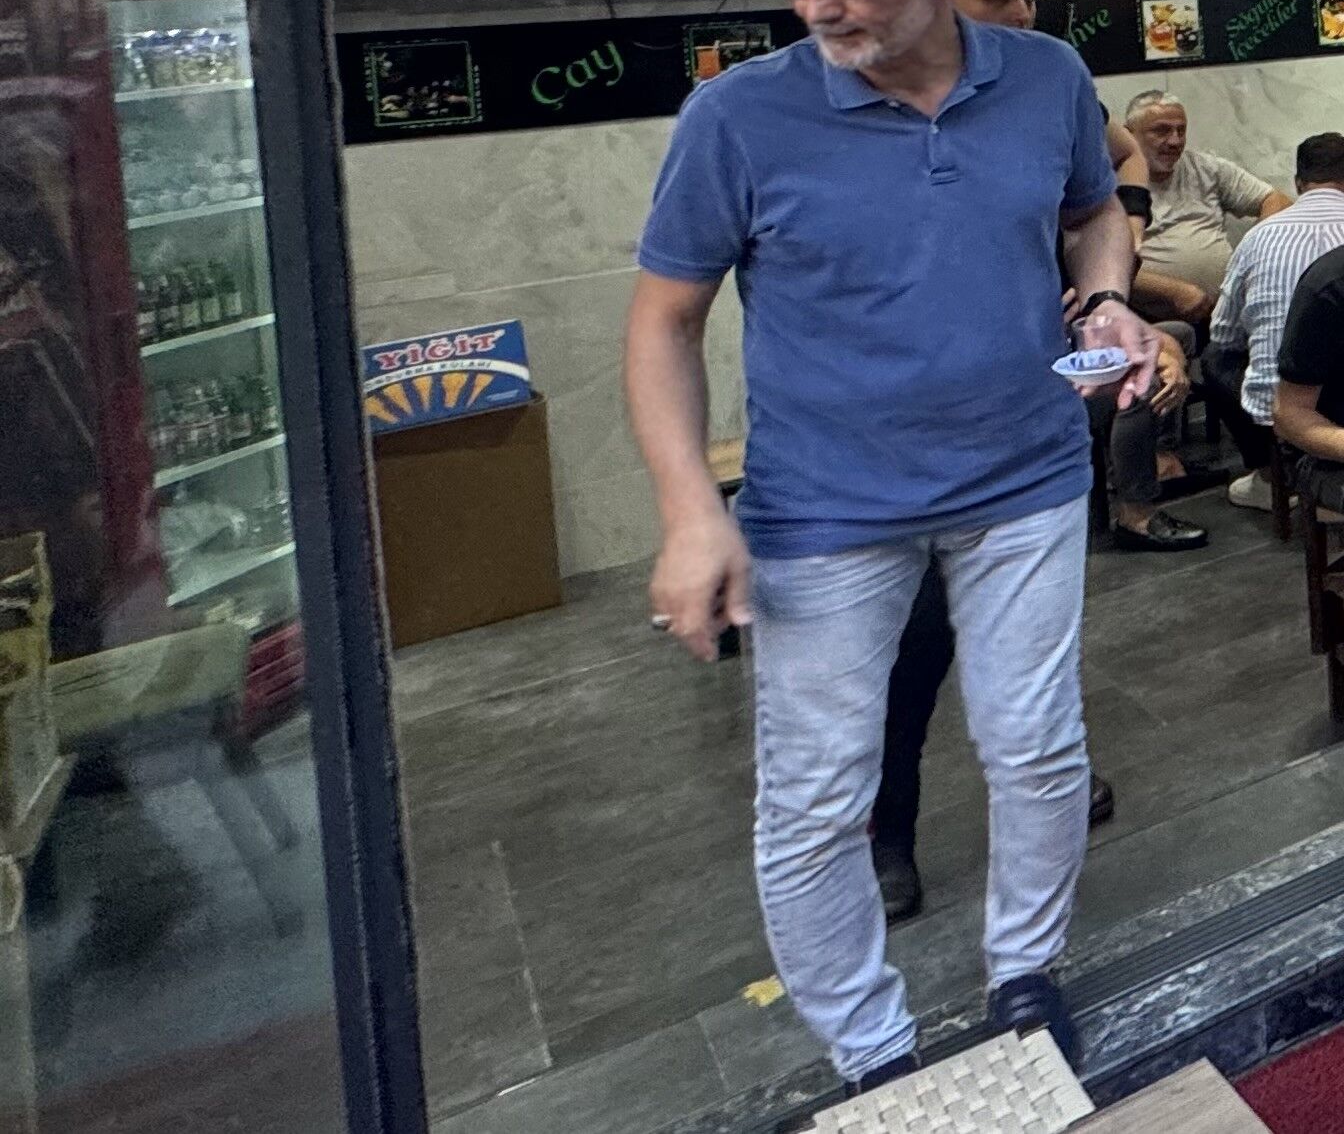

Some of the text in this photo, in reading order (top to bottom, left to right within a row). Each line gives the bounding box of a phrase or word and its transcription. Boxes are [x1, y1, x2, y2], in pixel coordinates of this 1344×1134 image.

[1065, 8, 1110, 47] hve
[530, 40, 625, 110] Çay
[372, 329, 506, 370] YİĞİT
